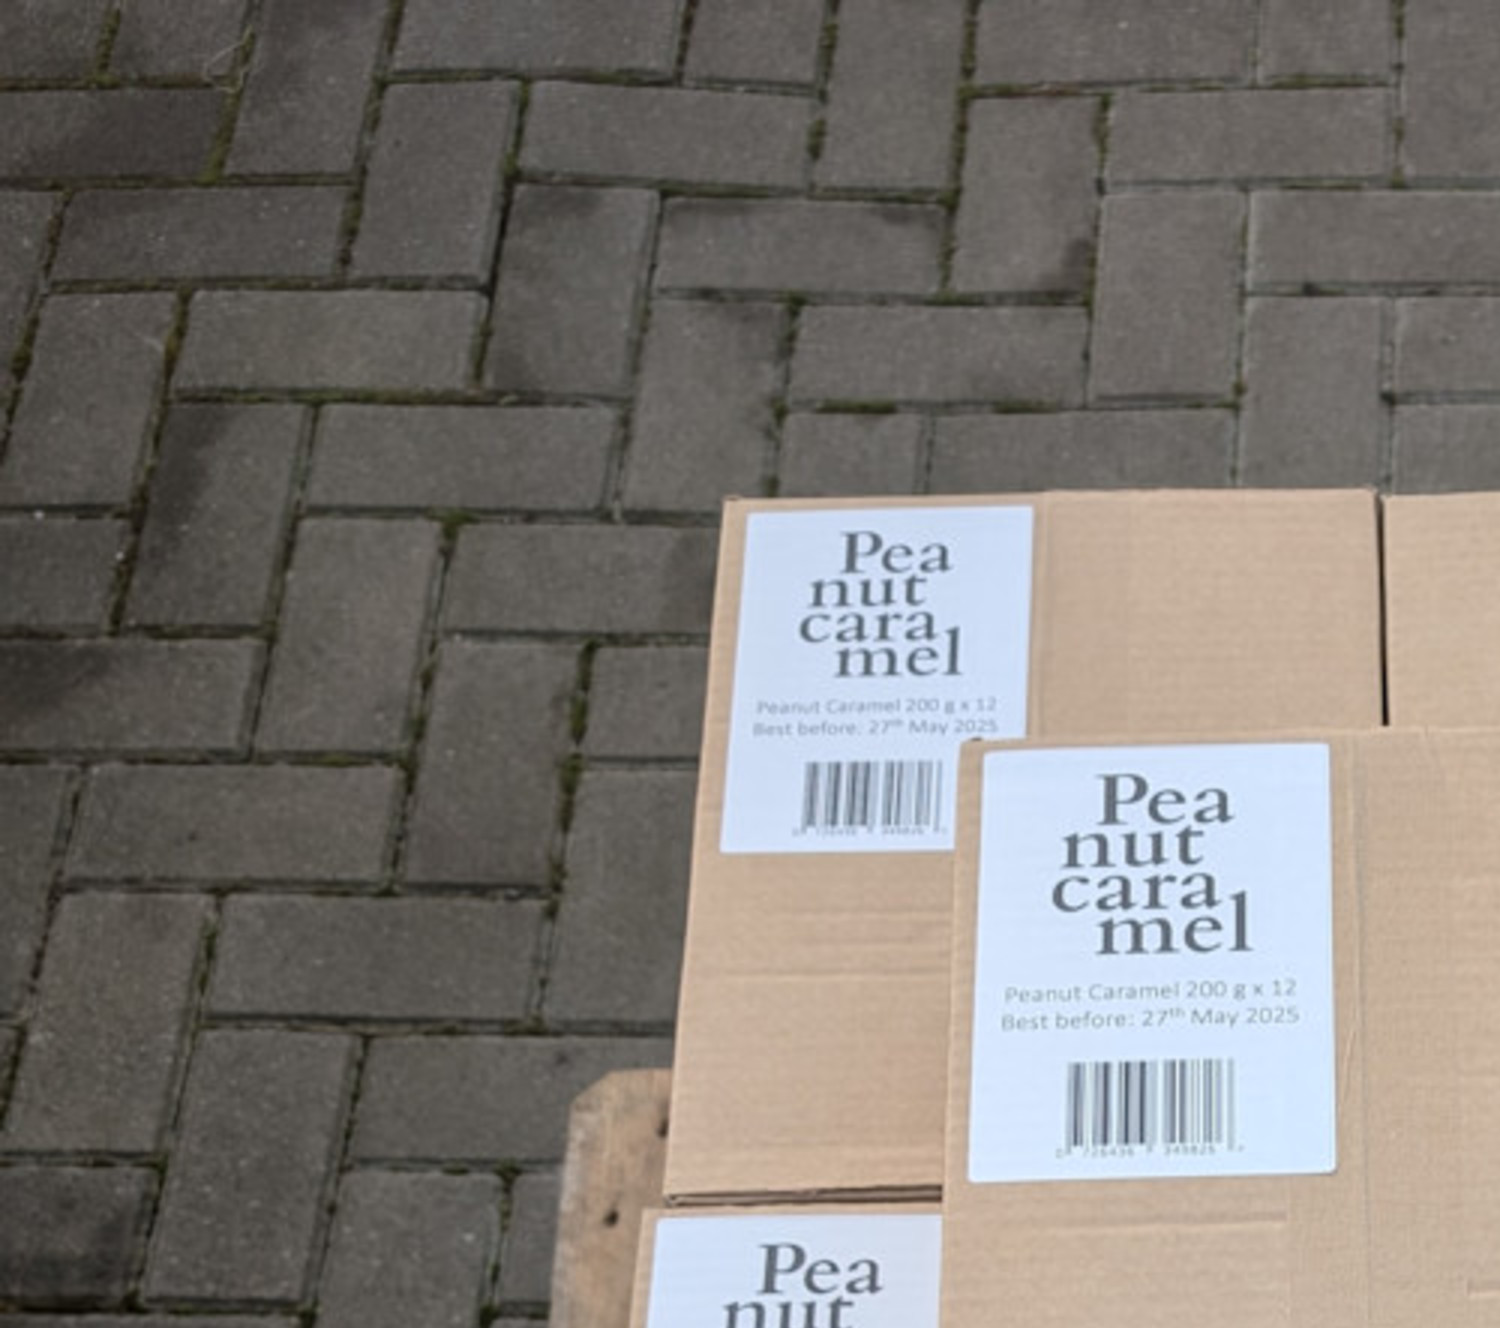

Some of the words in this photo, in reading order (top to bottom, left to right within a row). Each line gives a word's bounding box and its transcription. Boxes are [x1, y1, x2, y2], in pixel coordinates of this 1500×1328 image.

[841, 532, 952, 573] Pea
[811, 575, 927, 607] nut
[799, 612, 937, 643] cara
[836, 626, 962, 677] mel
[756, 700, 821, 715] Peanut
[825, 698, 901, 715] Caramel
[905, 698, 940, 713] 200
[944, 701, 955, 715] g
[960, 701, 969, 711] x
[975, 696, 997, 713] 12
[752, 722, 793, 737] Best
[908, 719, 949, 737] May
[953, 718, 999, 735] 2025
[1097, 774, 1235, 827] Pea
[1063, 824, 1204, 868] nut
[1052, 873, 1221, 912] cara
[1096, 889, 1253, 954] mel
[1004, 985, 1082, 1003] Peanut
[1088, 981, 1180, 1001] Caramel
[1186, 980, 1228, 999] 200
[1233, 983, 1246, 1001] g
[1253, 984, 1263, 996] x
[1272, 977, 1297, 997] 12
[1001, 1014, 1049, 1032] Best
[1190, 1007, 1240, 1028] May
[1245, 1005, 1300, 1025] 2025
[758, 1244, 884, 1294] Pea
